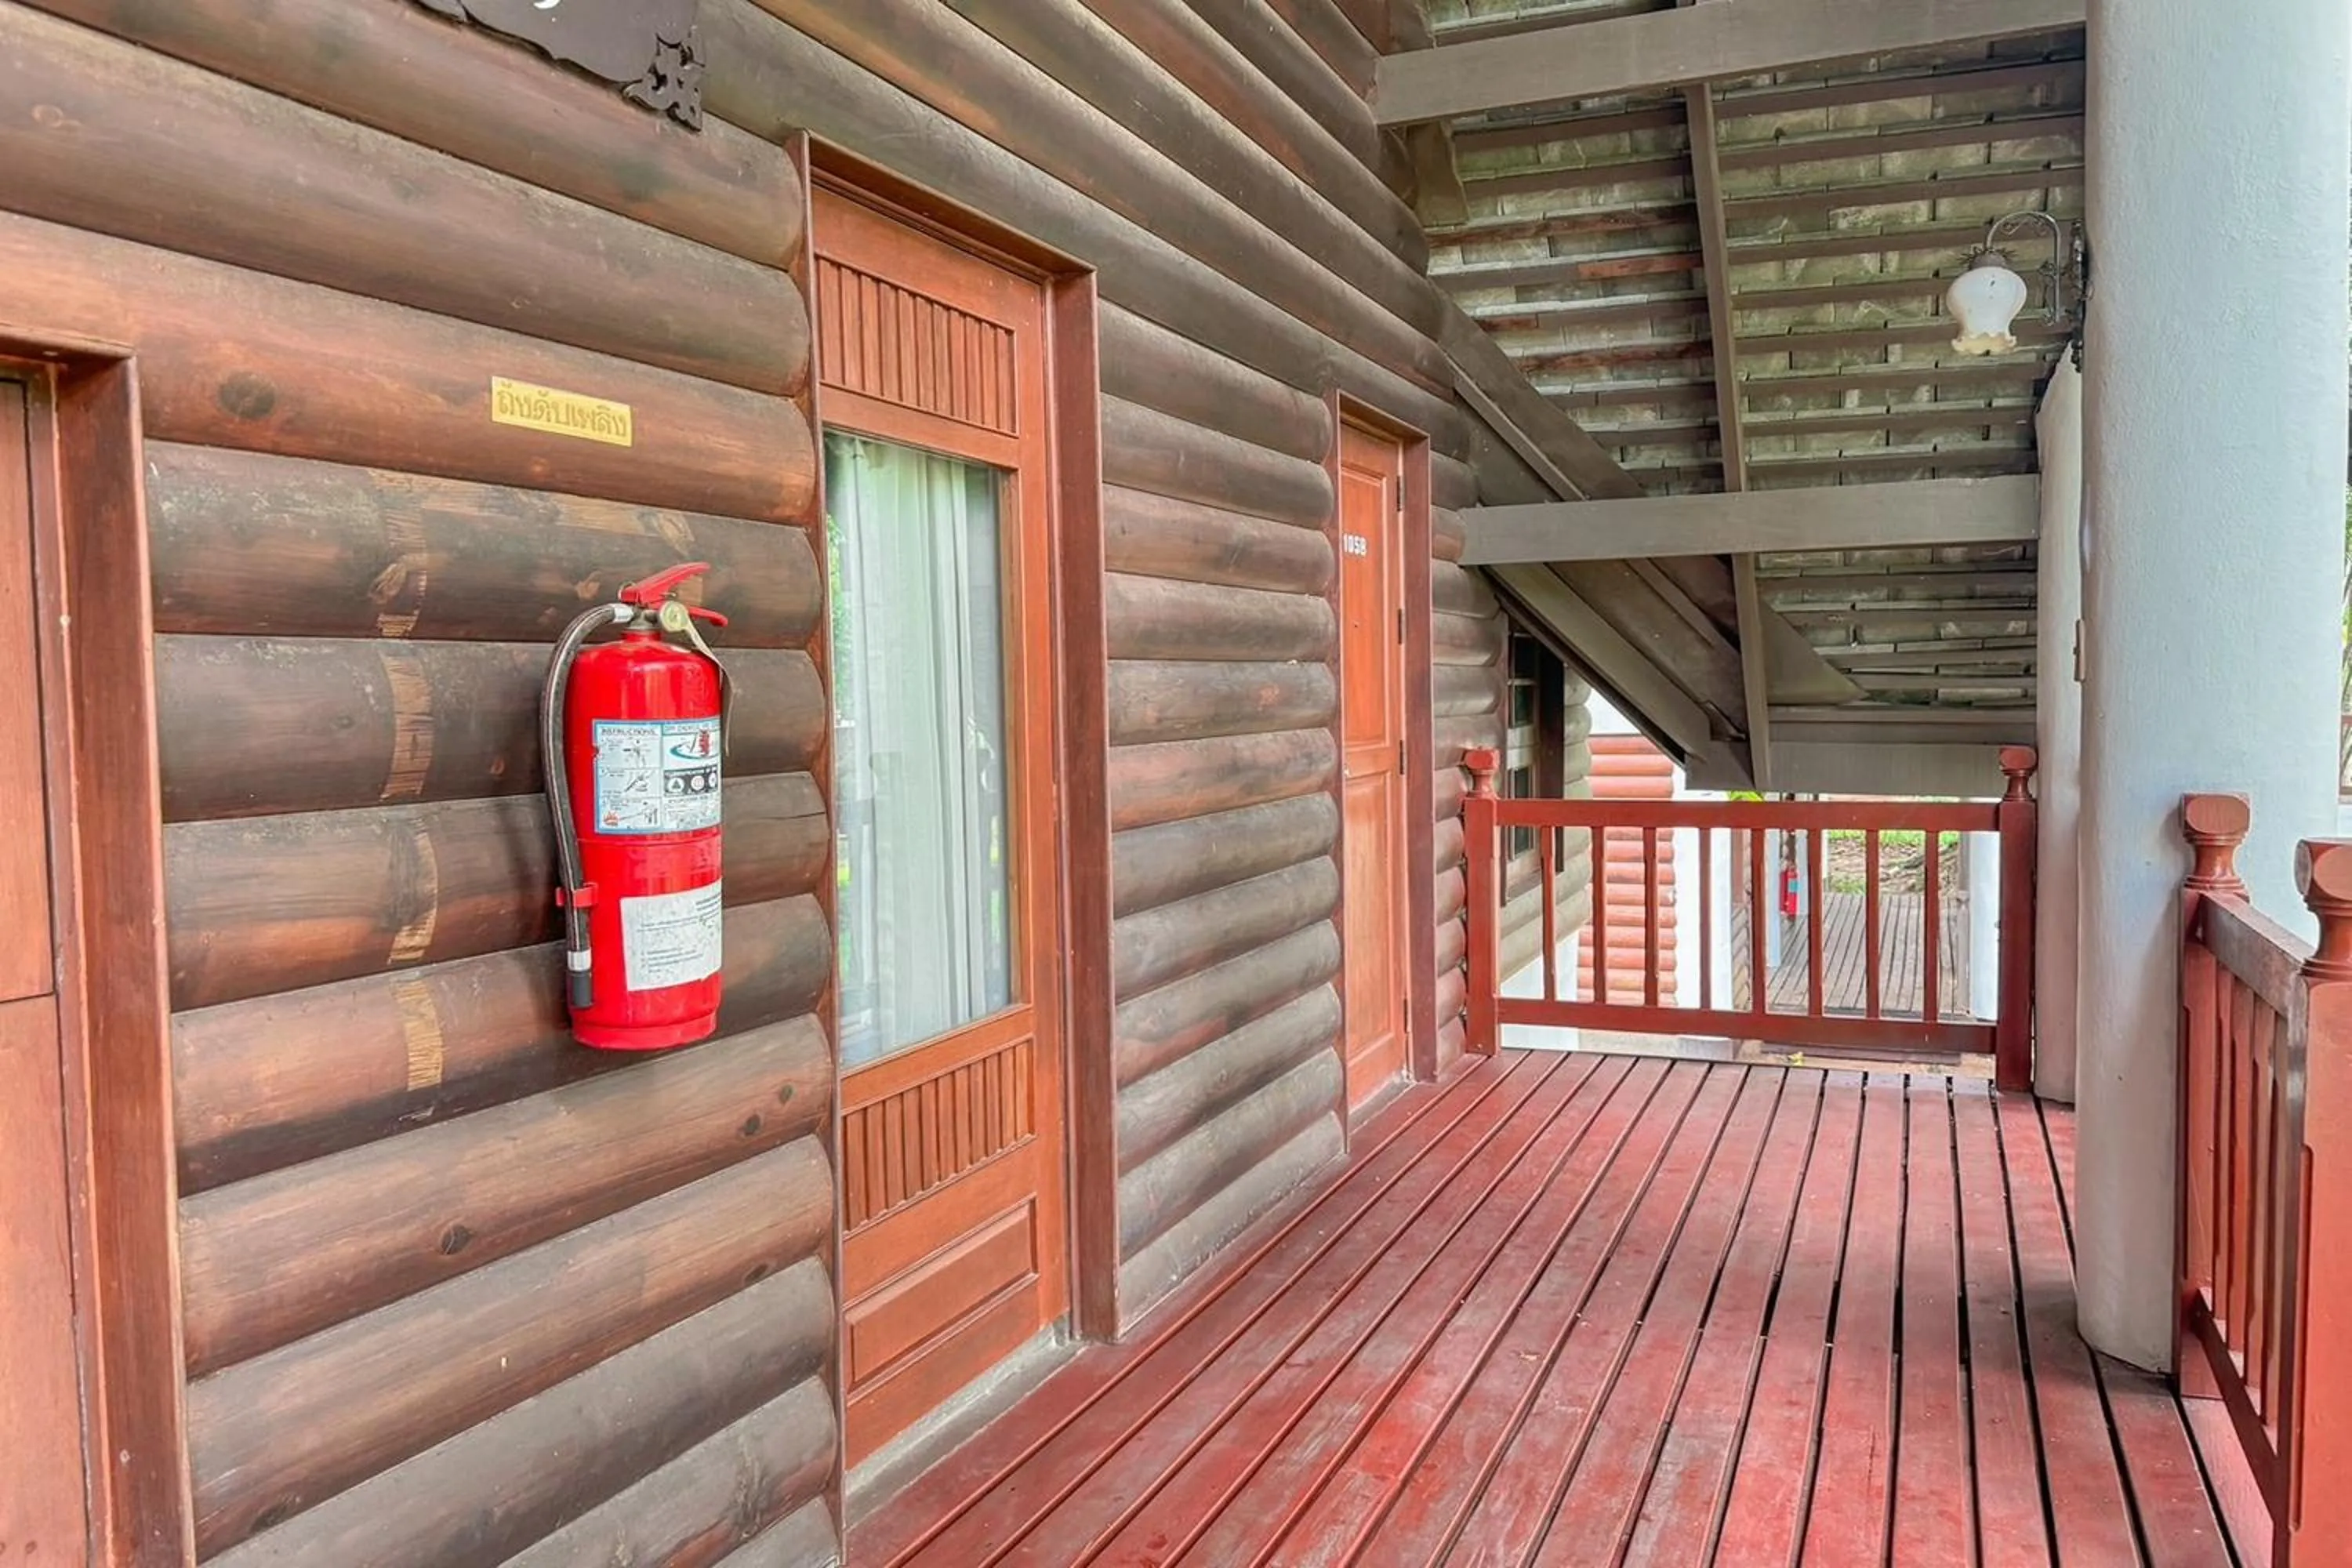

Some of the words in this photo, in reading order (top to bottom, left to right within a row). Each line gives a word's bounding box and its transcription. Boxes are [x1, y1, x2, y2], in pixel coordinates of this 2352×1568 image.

[497, 380, 627, 437] ถังดับเพลิง
